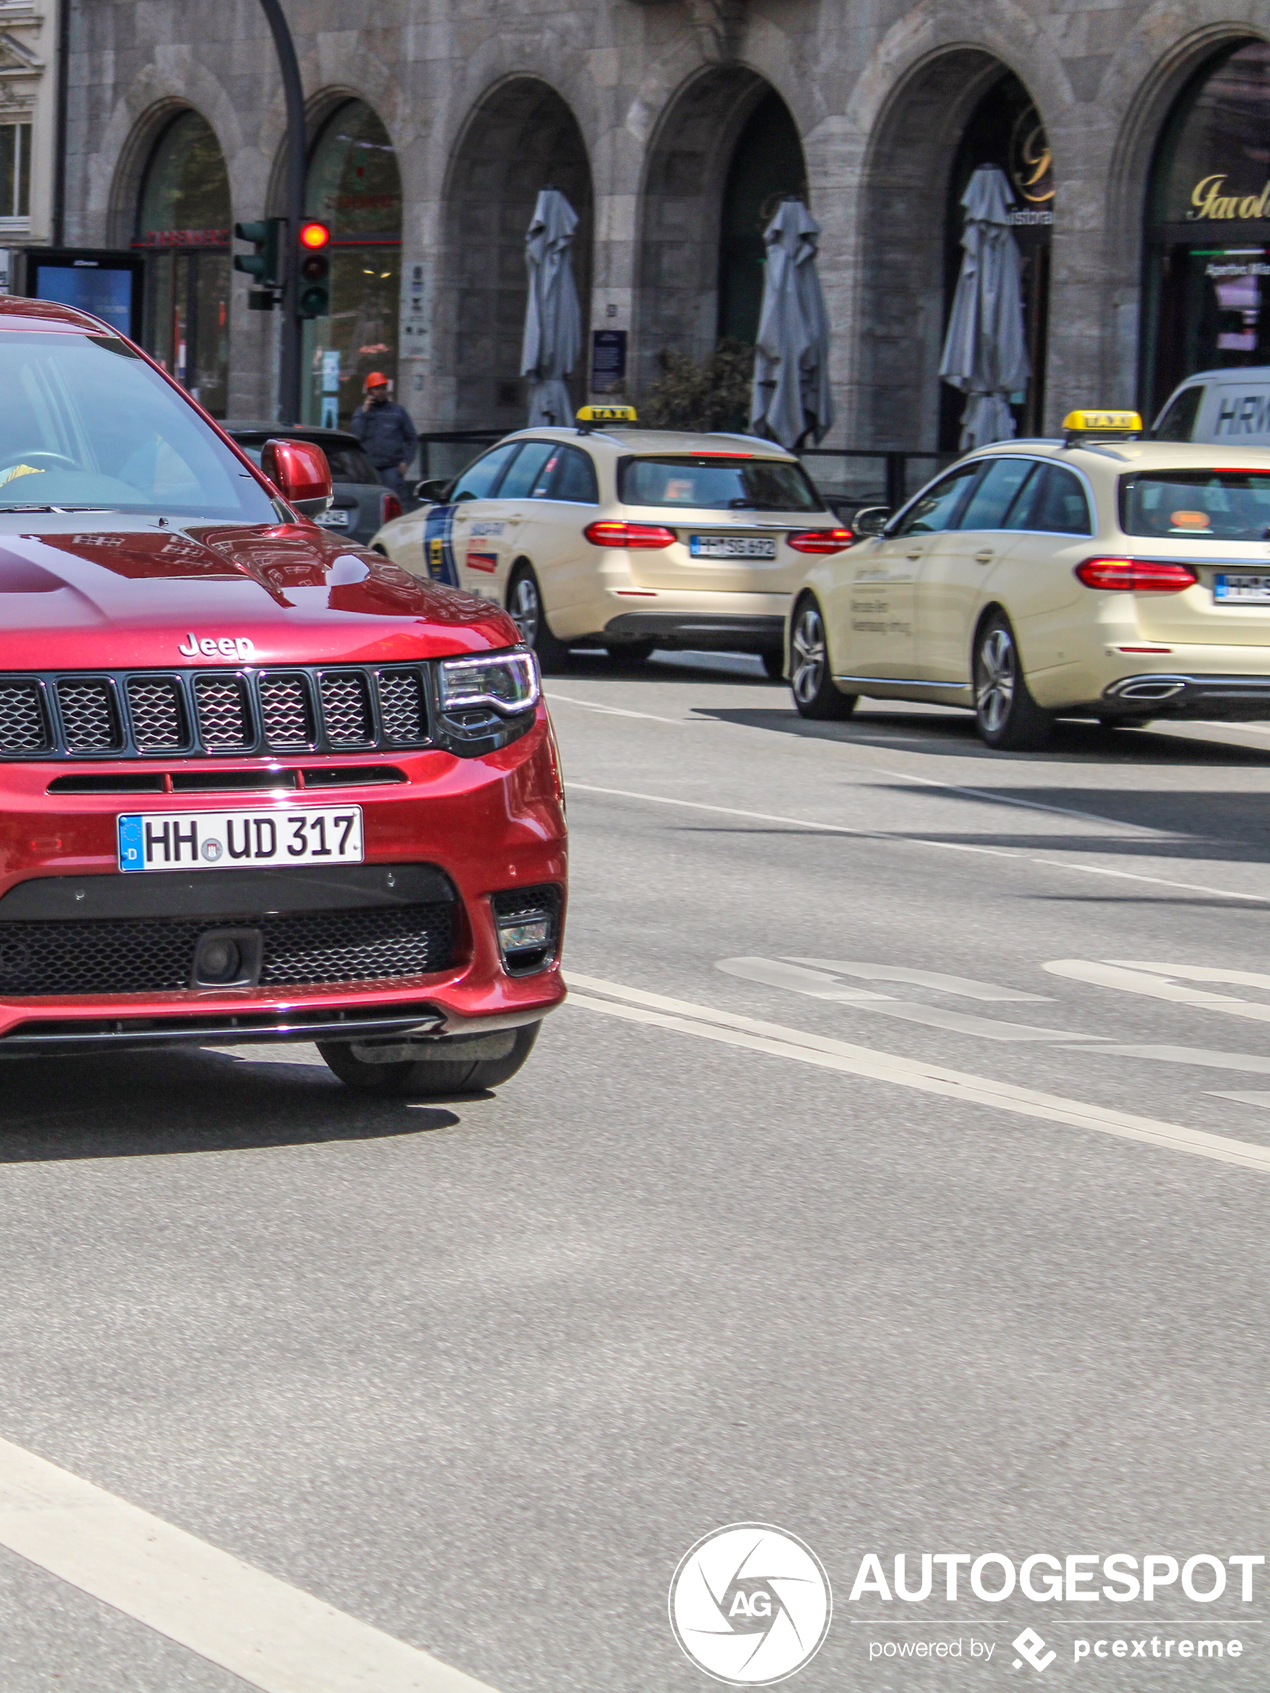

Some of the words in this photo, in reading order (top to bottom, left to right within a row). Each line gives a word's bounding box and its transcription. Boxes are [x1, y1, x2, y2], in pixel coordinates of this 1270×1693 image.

[592, 408, 629, 420] TAXI
[1084, 414, 1132, 428] TAXI
[178, 632, 255, 663] Jeep
[145, 820, 198, 862] HH
[227, 818, 278, 859] UD
[287, 815, 355, 857] 317
[127, 848, 138, 861] D
